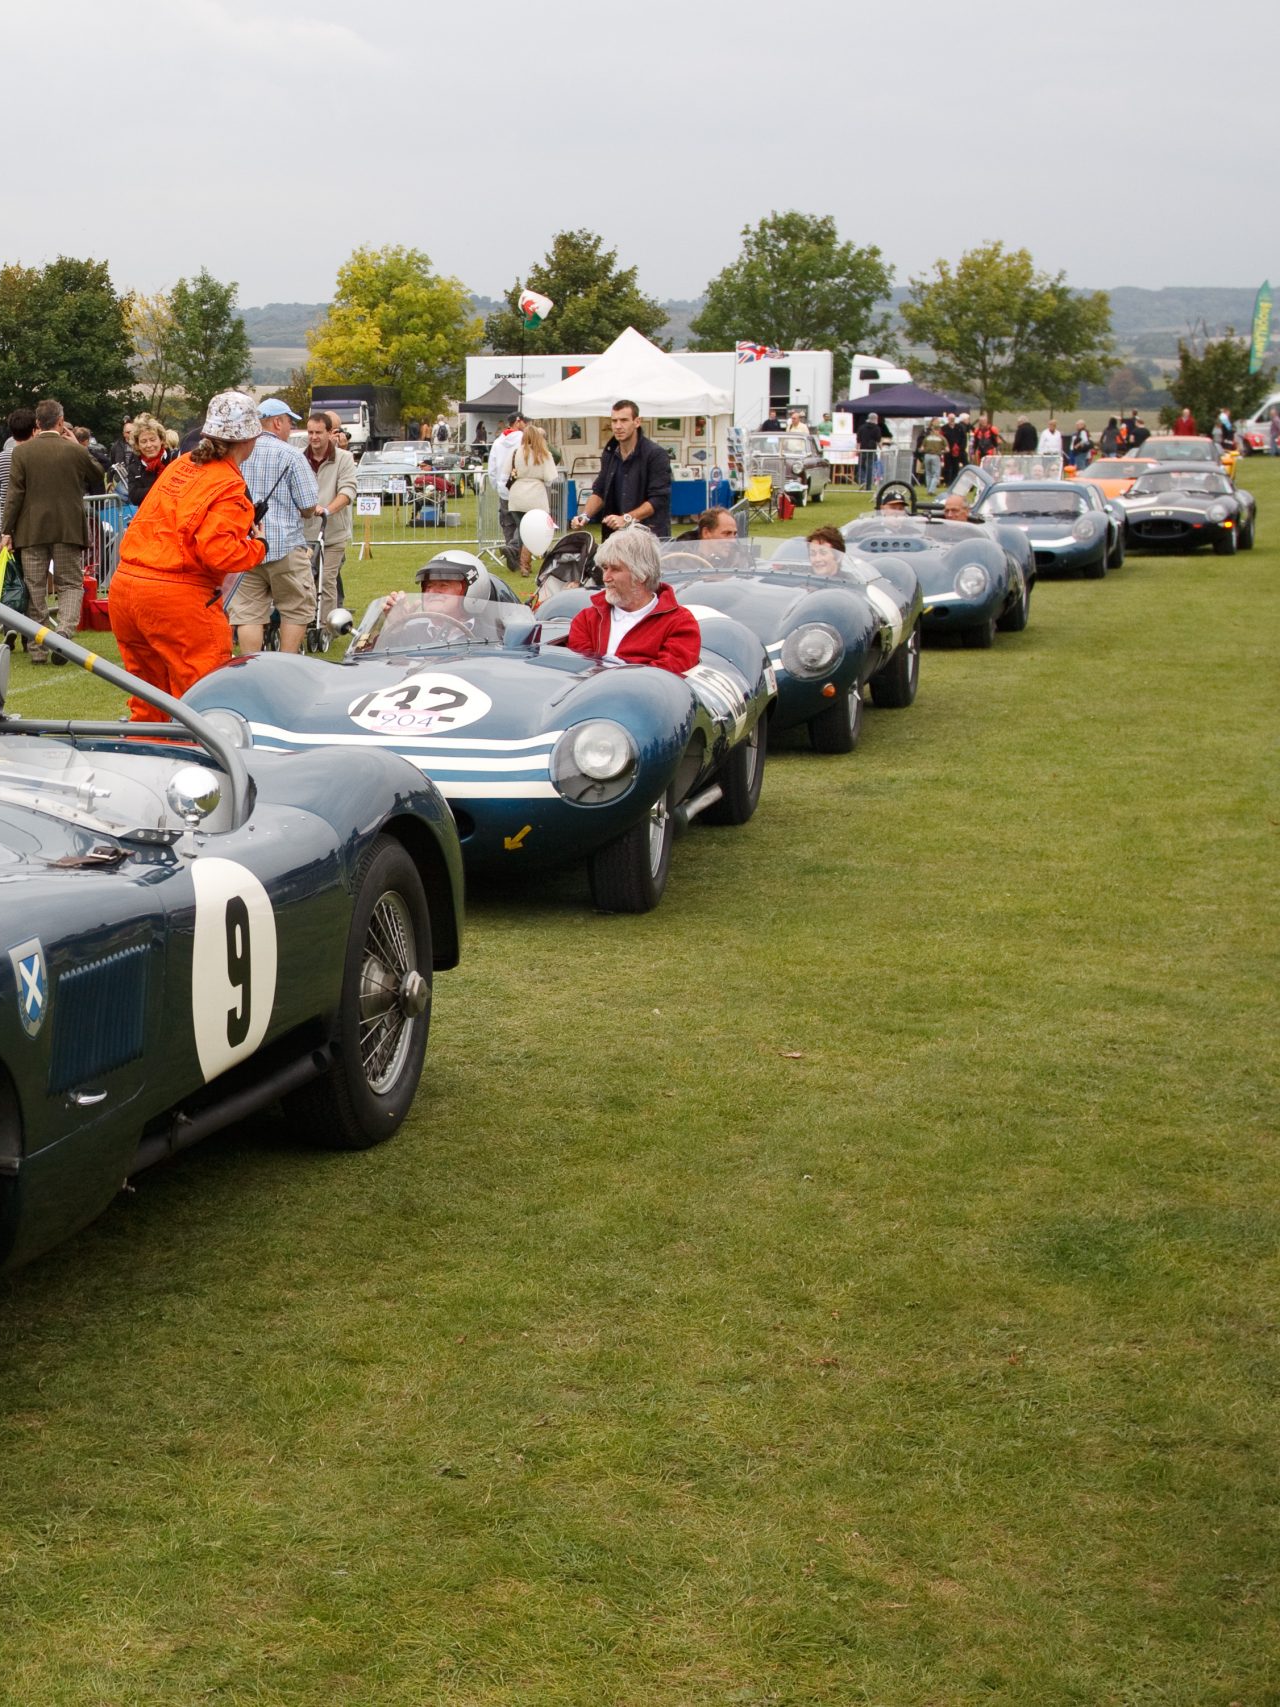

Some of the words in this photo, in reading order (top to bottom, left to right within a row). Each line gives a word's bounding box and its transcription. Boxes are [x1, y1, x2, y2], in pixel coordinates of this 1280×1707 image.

[360, 502, 377, 511] 537
[381, 713, 434, 728] 904
[225, 895, 252, 1048] 9
